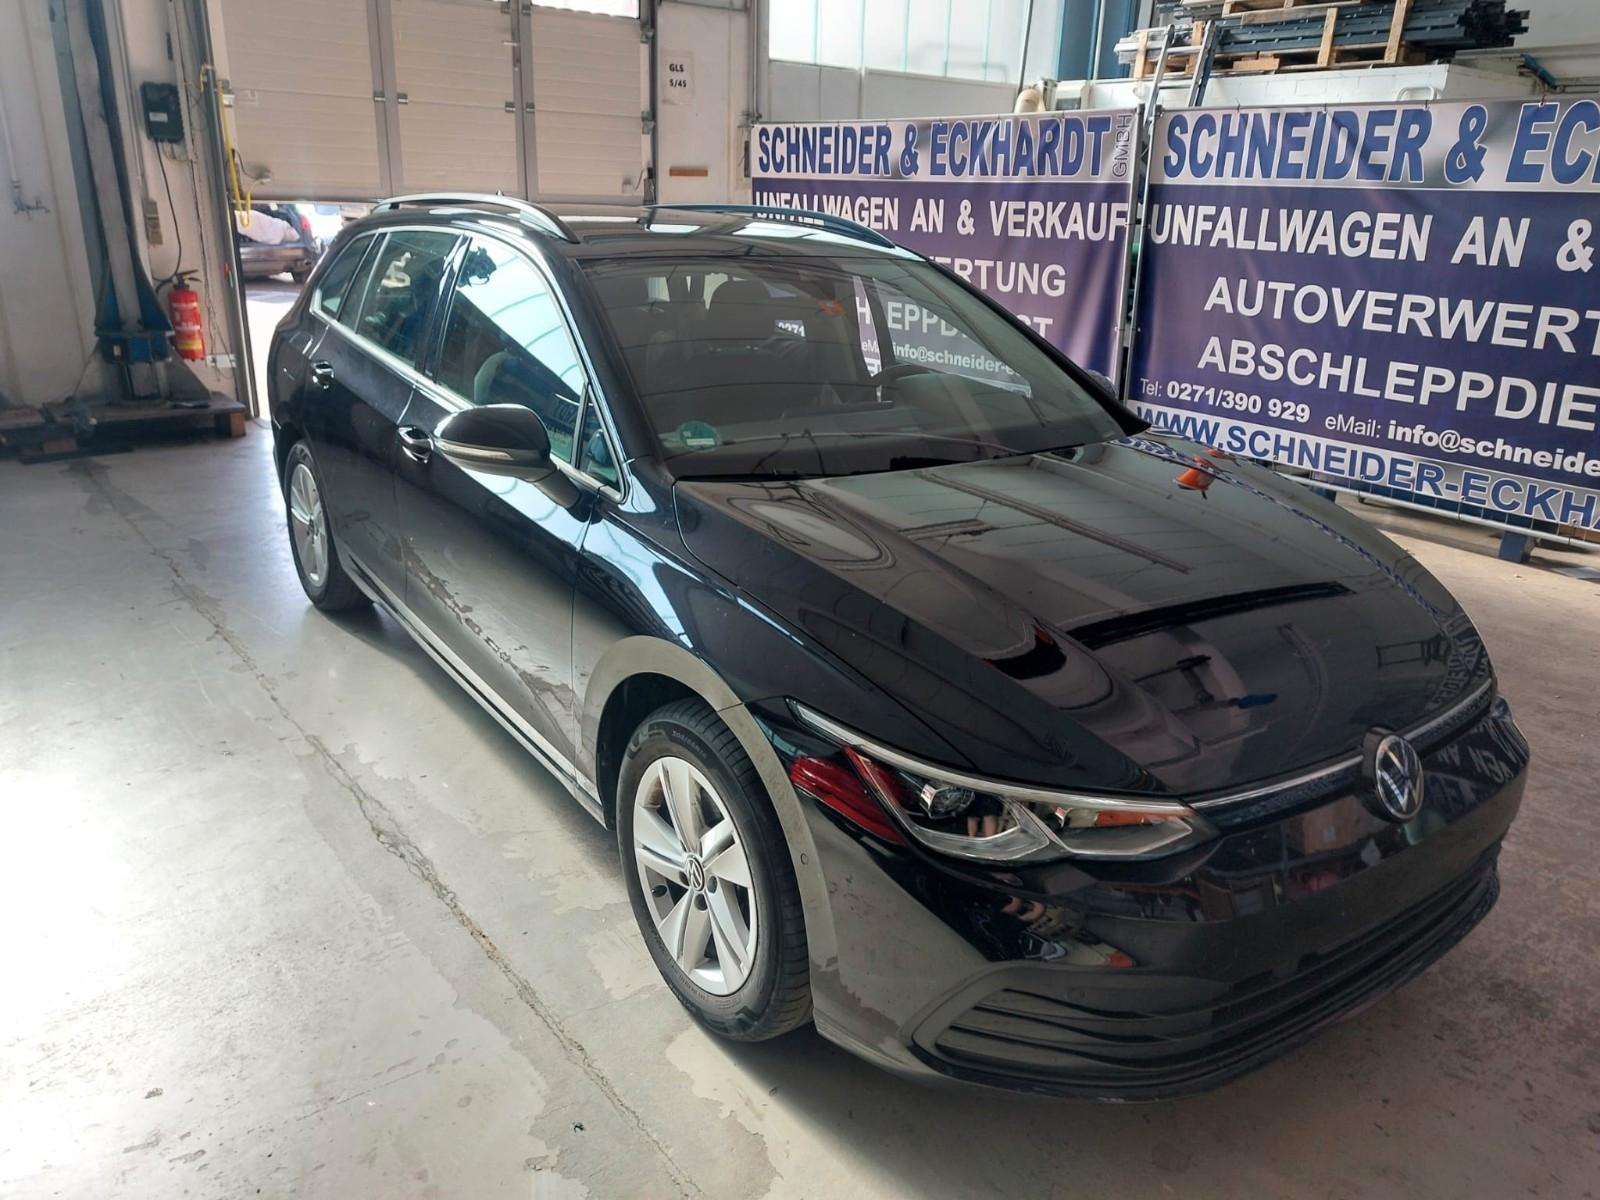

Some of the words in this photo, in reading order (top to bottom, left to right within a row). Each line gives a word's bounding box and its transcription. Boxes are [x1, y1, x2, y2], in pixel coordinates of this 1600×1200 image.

[669, 63, 685, 73] GLS
[758, 124, 892, 176] SCHNEIDER
[900, 123, 919, 177] &
[930, 116, 1112, 177] ECKHARDT
[1112, 114, 1133, 178] GMBH
[1163, 108, 1433, 183] SCHNEIDER
[1444, 104, 1488, 184] &
[1505, 100, 1600, 185] EC
[911, 199, 944, 234] AN
[956, 199, 976, 236] &
[990, 200, 1129, 242] VERKAUF
[1151, 203, 1433, 262] UNFALLWAGEN
[1450, 216, 1530, 268] AN
[1556, 218, 1595, 273] &
[1140, 378, 1162, 397] Tel:
[1166, 380, 1262, 414] 0271/390
[1267, 398, 1311, 423] 929
[1325, 414, 1381, 439] eMail:
[1197, 335, 1600, 431] ABSCHLEPPDIE
[1136, 406, 1600, 533] WWW.SCHNEIDER-ECKH
